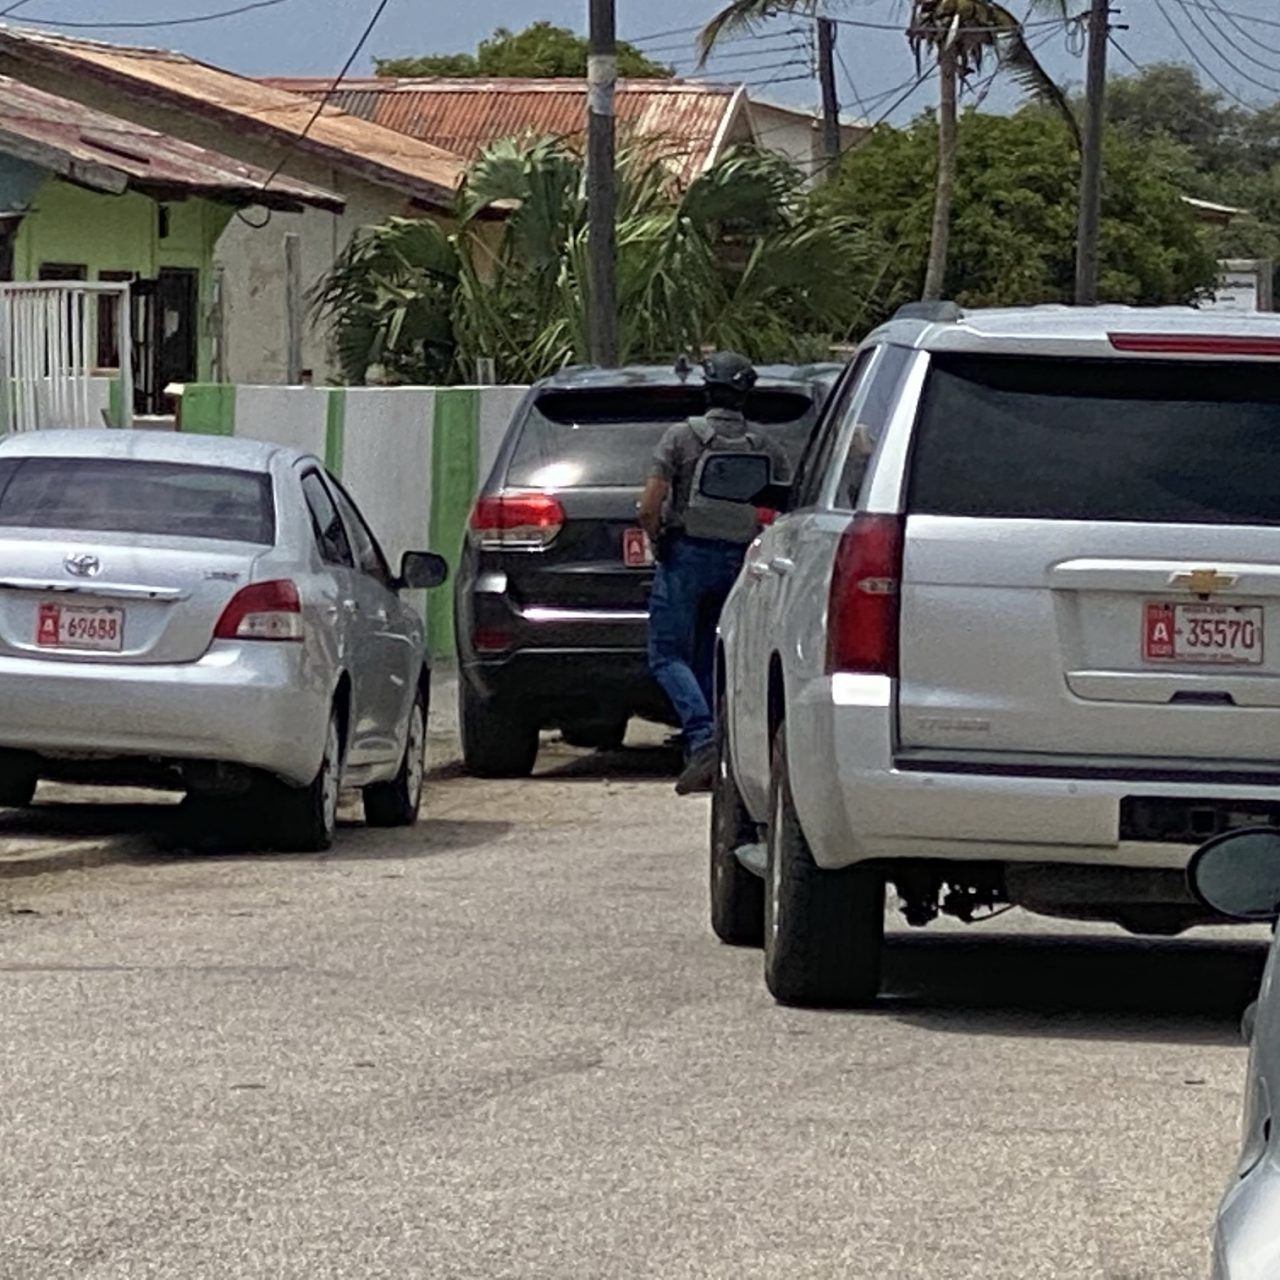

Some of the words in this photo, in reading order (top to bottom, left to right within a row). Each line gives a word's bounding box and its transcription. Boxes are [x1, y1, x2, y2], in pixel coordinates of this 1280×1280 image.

[43, 618, 55, 634] A
[1153, 622, 1169, 642] A
[1186, 619, 1254, 649] 35570
